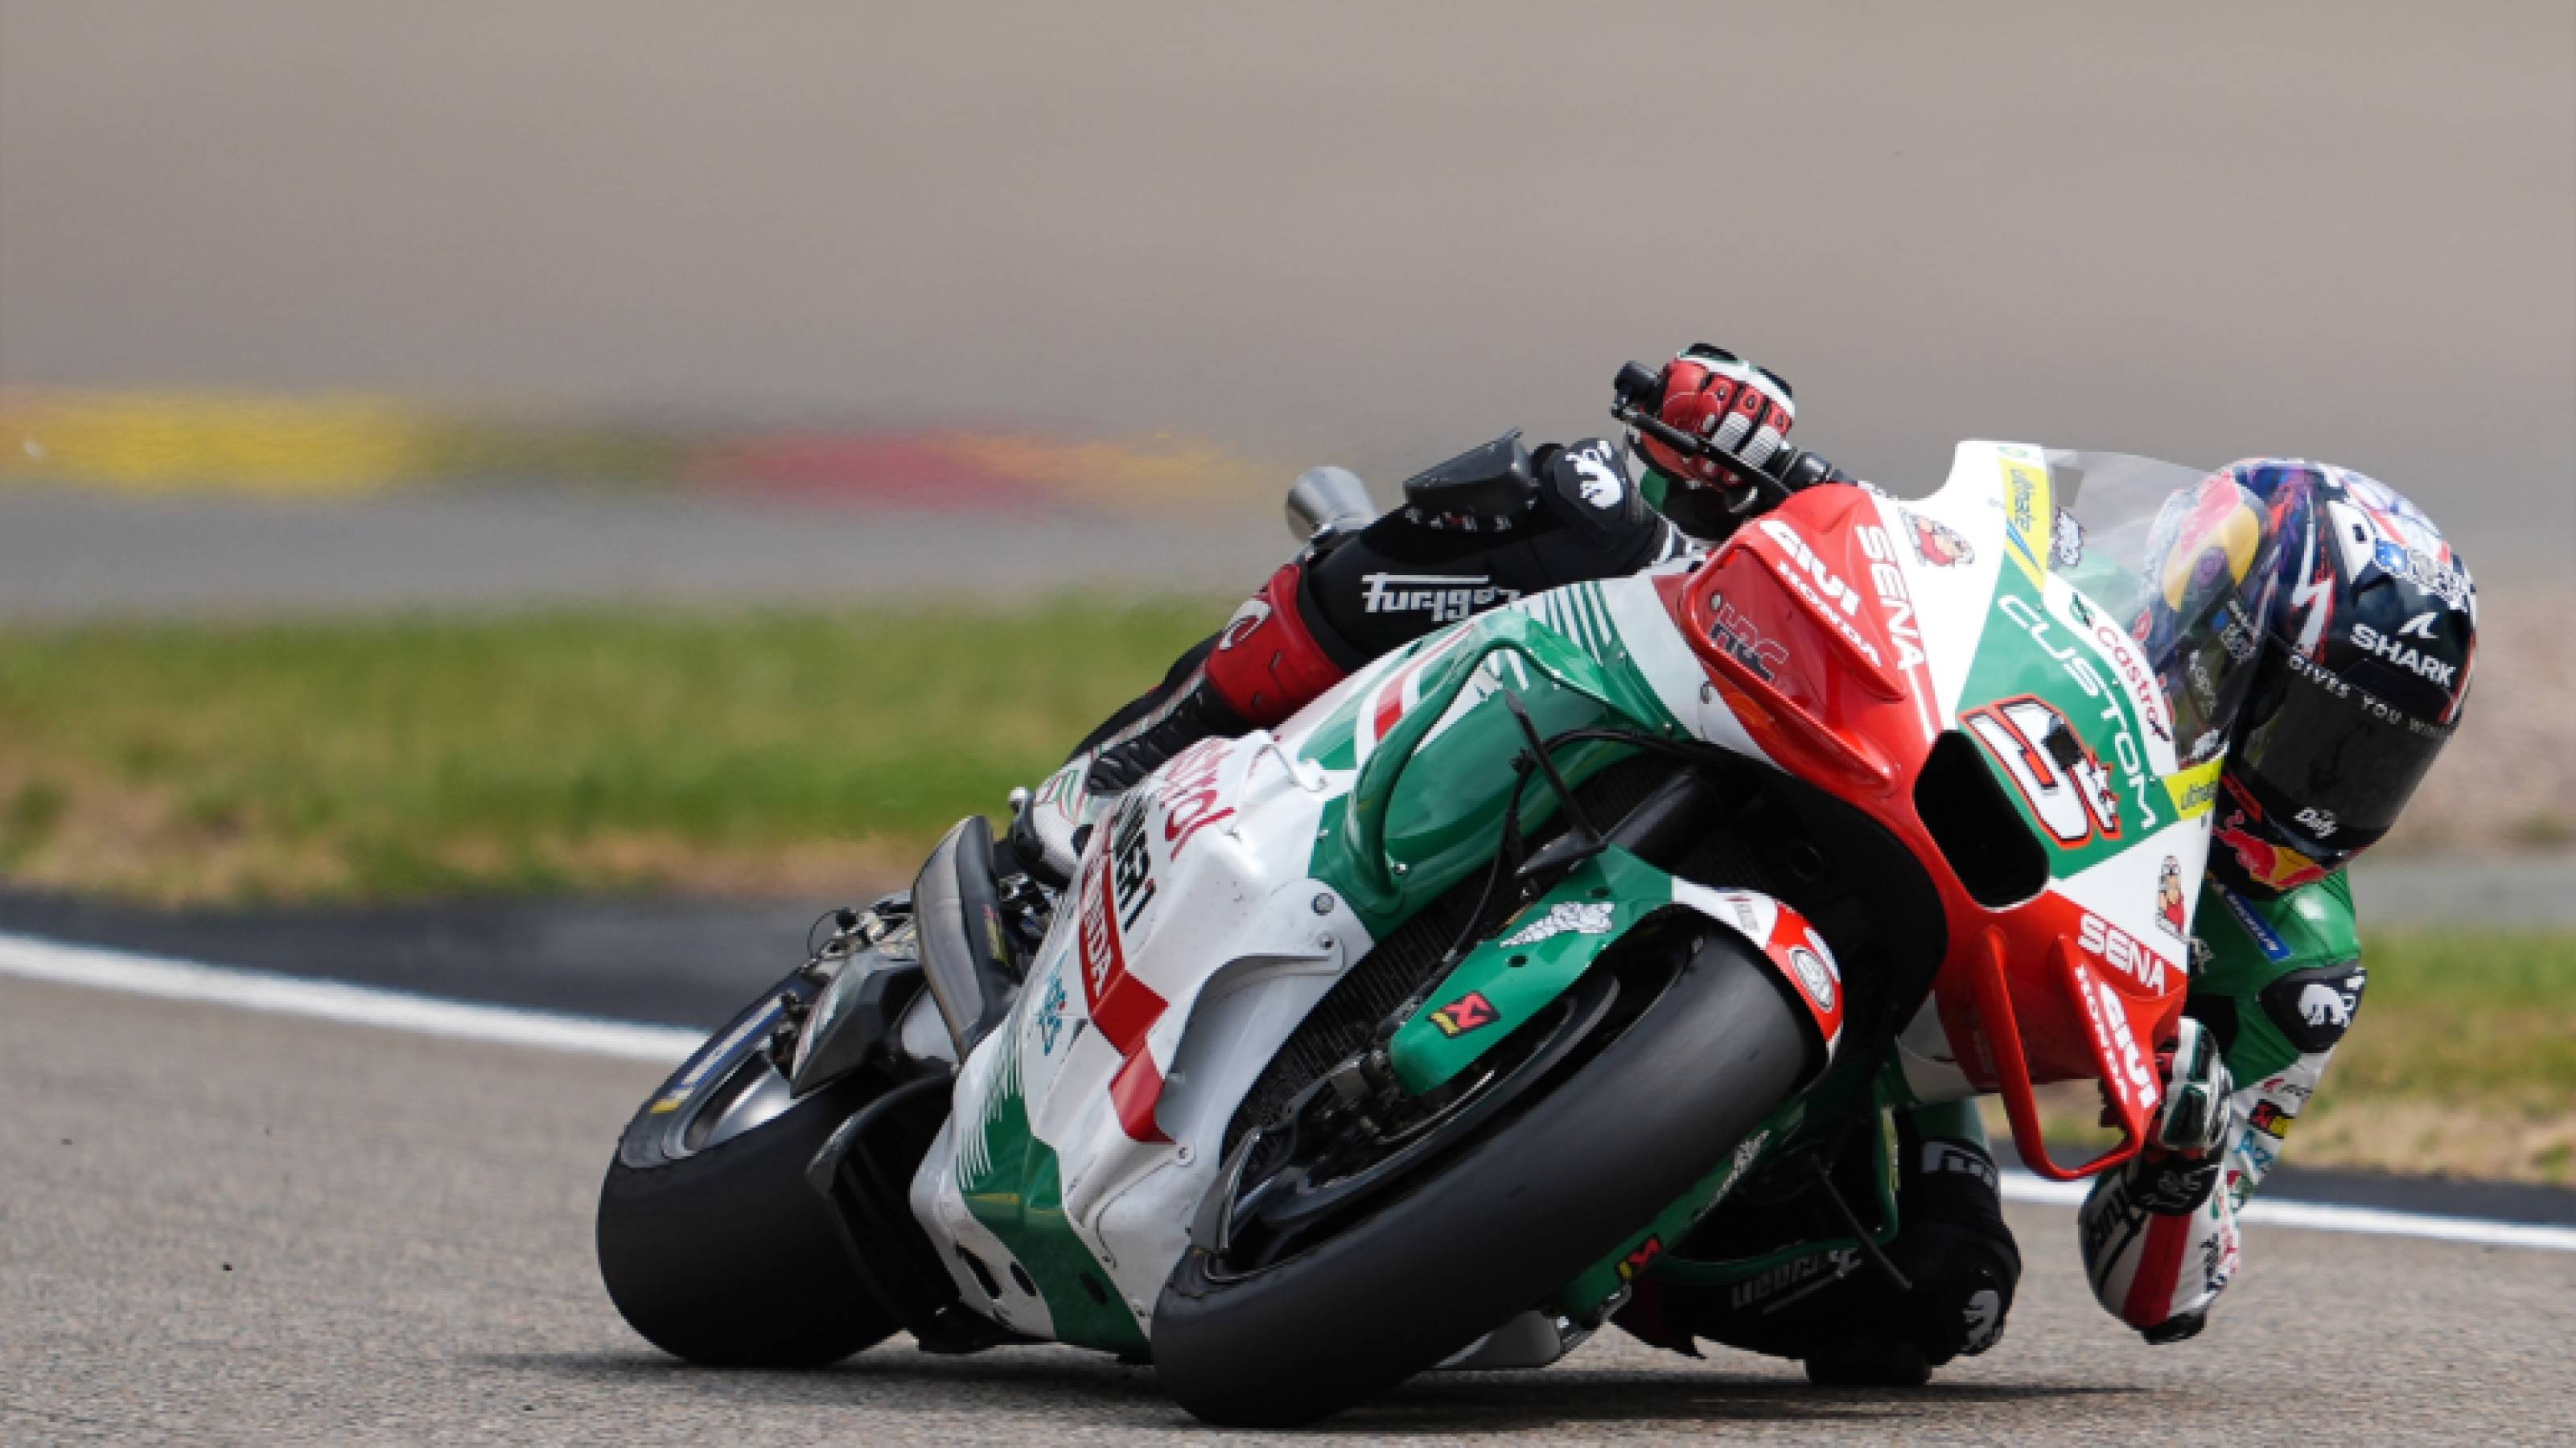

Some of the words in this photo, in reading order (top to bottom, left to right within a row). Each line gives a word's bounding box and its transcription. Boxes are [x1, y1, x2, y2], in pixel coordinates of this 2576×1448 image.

[1759, 519, 1860, 617] GIVI
[1855, 524, 1924, 672] SENA
[1998, 594, 2158, 830] CUSTOM
[2350, 623, 2457, 689] SHARK
[2360, 694, 2402, 725] YOU
[1957, 693, 2122, 849] 5
[2078, 914, 2167, 996] SENA
[2098, 982, 2159, 1109] GIVI
